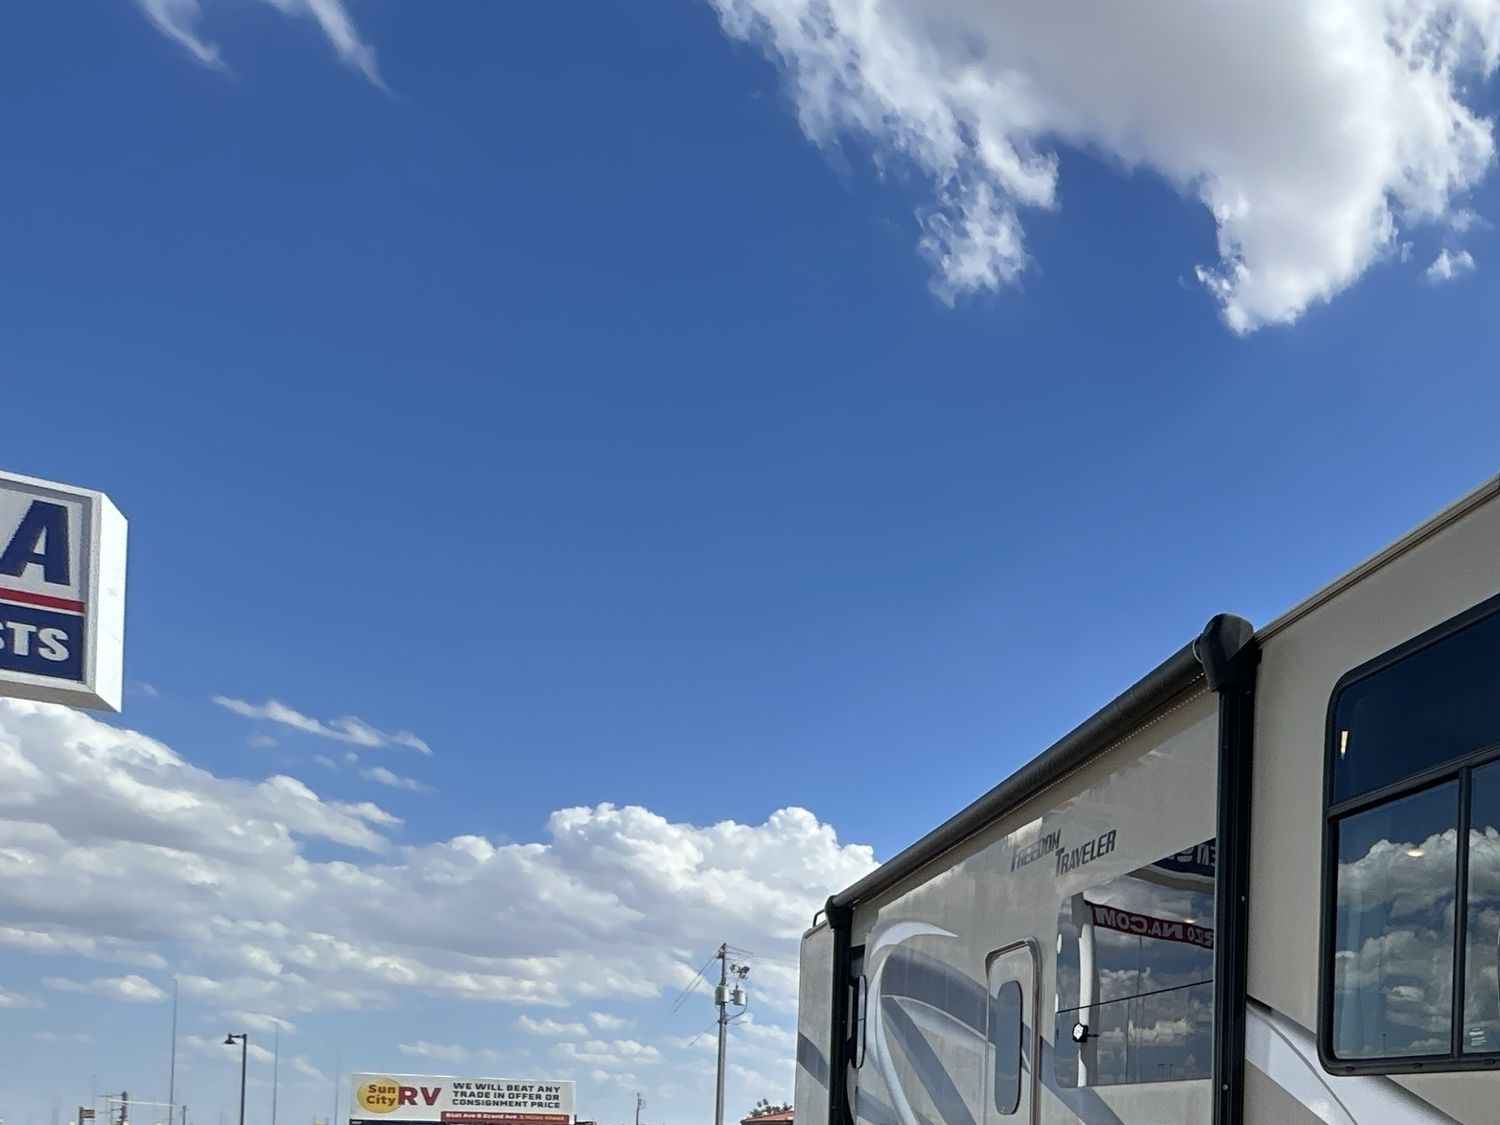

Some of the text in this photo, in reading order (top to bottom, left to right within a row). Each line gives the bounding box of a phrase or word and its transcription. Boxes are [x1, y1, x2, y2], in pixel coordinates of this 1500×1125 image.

[0, 499, 71, 586] A
[0, 619, 71, 662] TS
[1056, 829, 1117, 878] TRAVELER
[368, 1084, 396, 1094] Sun
[453, 1082, 472, 1090] WE
[475, 1083, 504, 1091] WILL
[506, 1084, 534, 1092] BEAT
[366, 1095, 397, 1106] City
[398, 1086, 442, 1106] RV
[508, 1092, 543, 1100] OFFER
[452, 1099, 528, 1107] CONSIGNMENT
